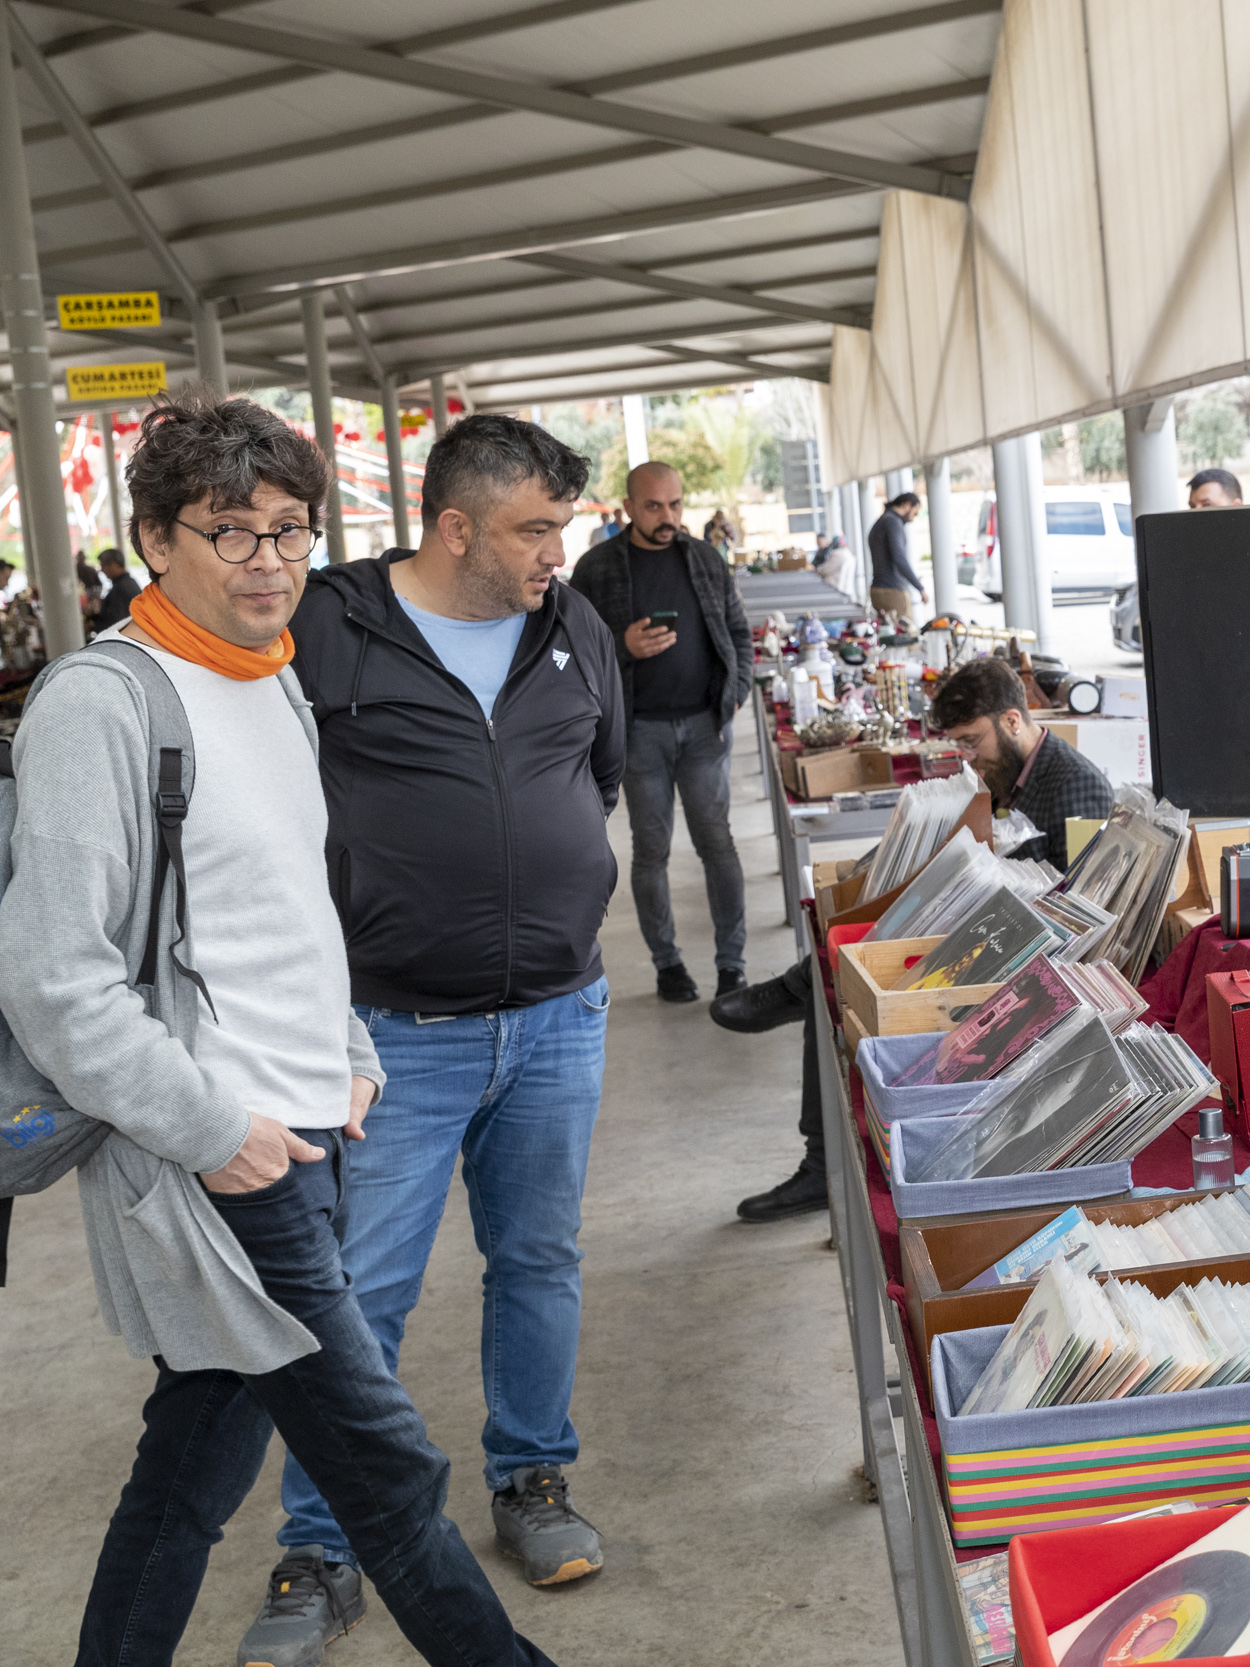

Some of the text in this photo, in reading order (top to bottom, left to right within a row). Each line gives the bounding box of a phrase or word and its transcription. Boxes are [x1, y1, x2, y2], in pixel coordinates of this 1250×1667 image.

[63, 298, 154, 313] ÇARŞAMBA
[71, 368, 161, 384] CUMARTESİ
[0, 1109, 56, 1149] bilgi
